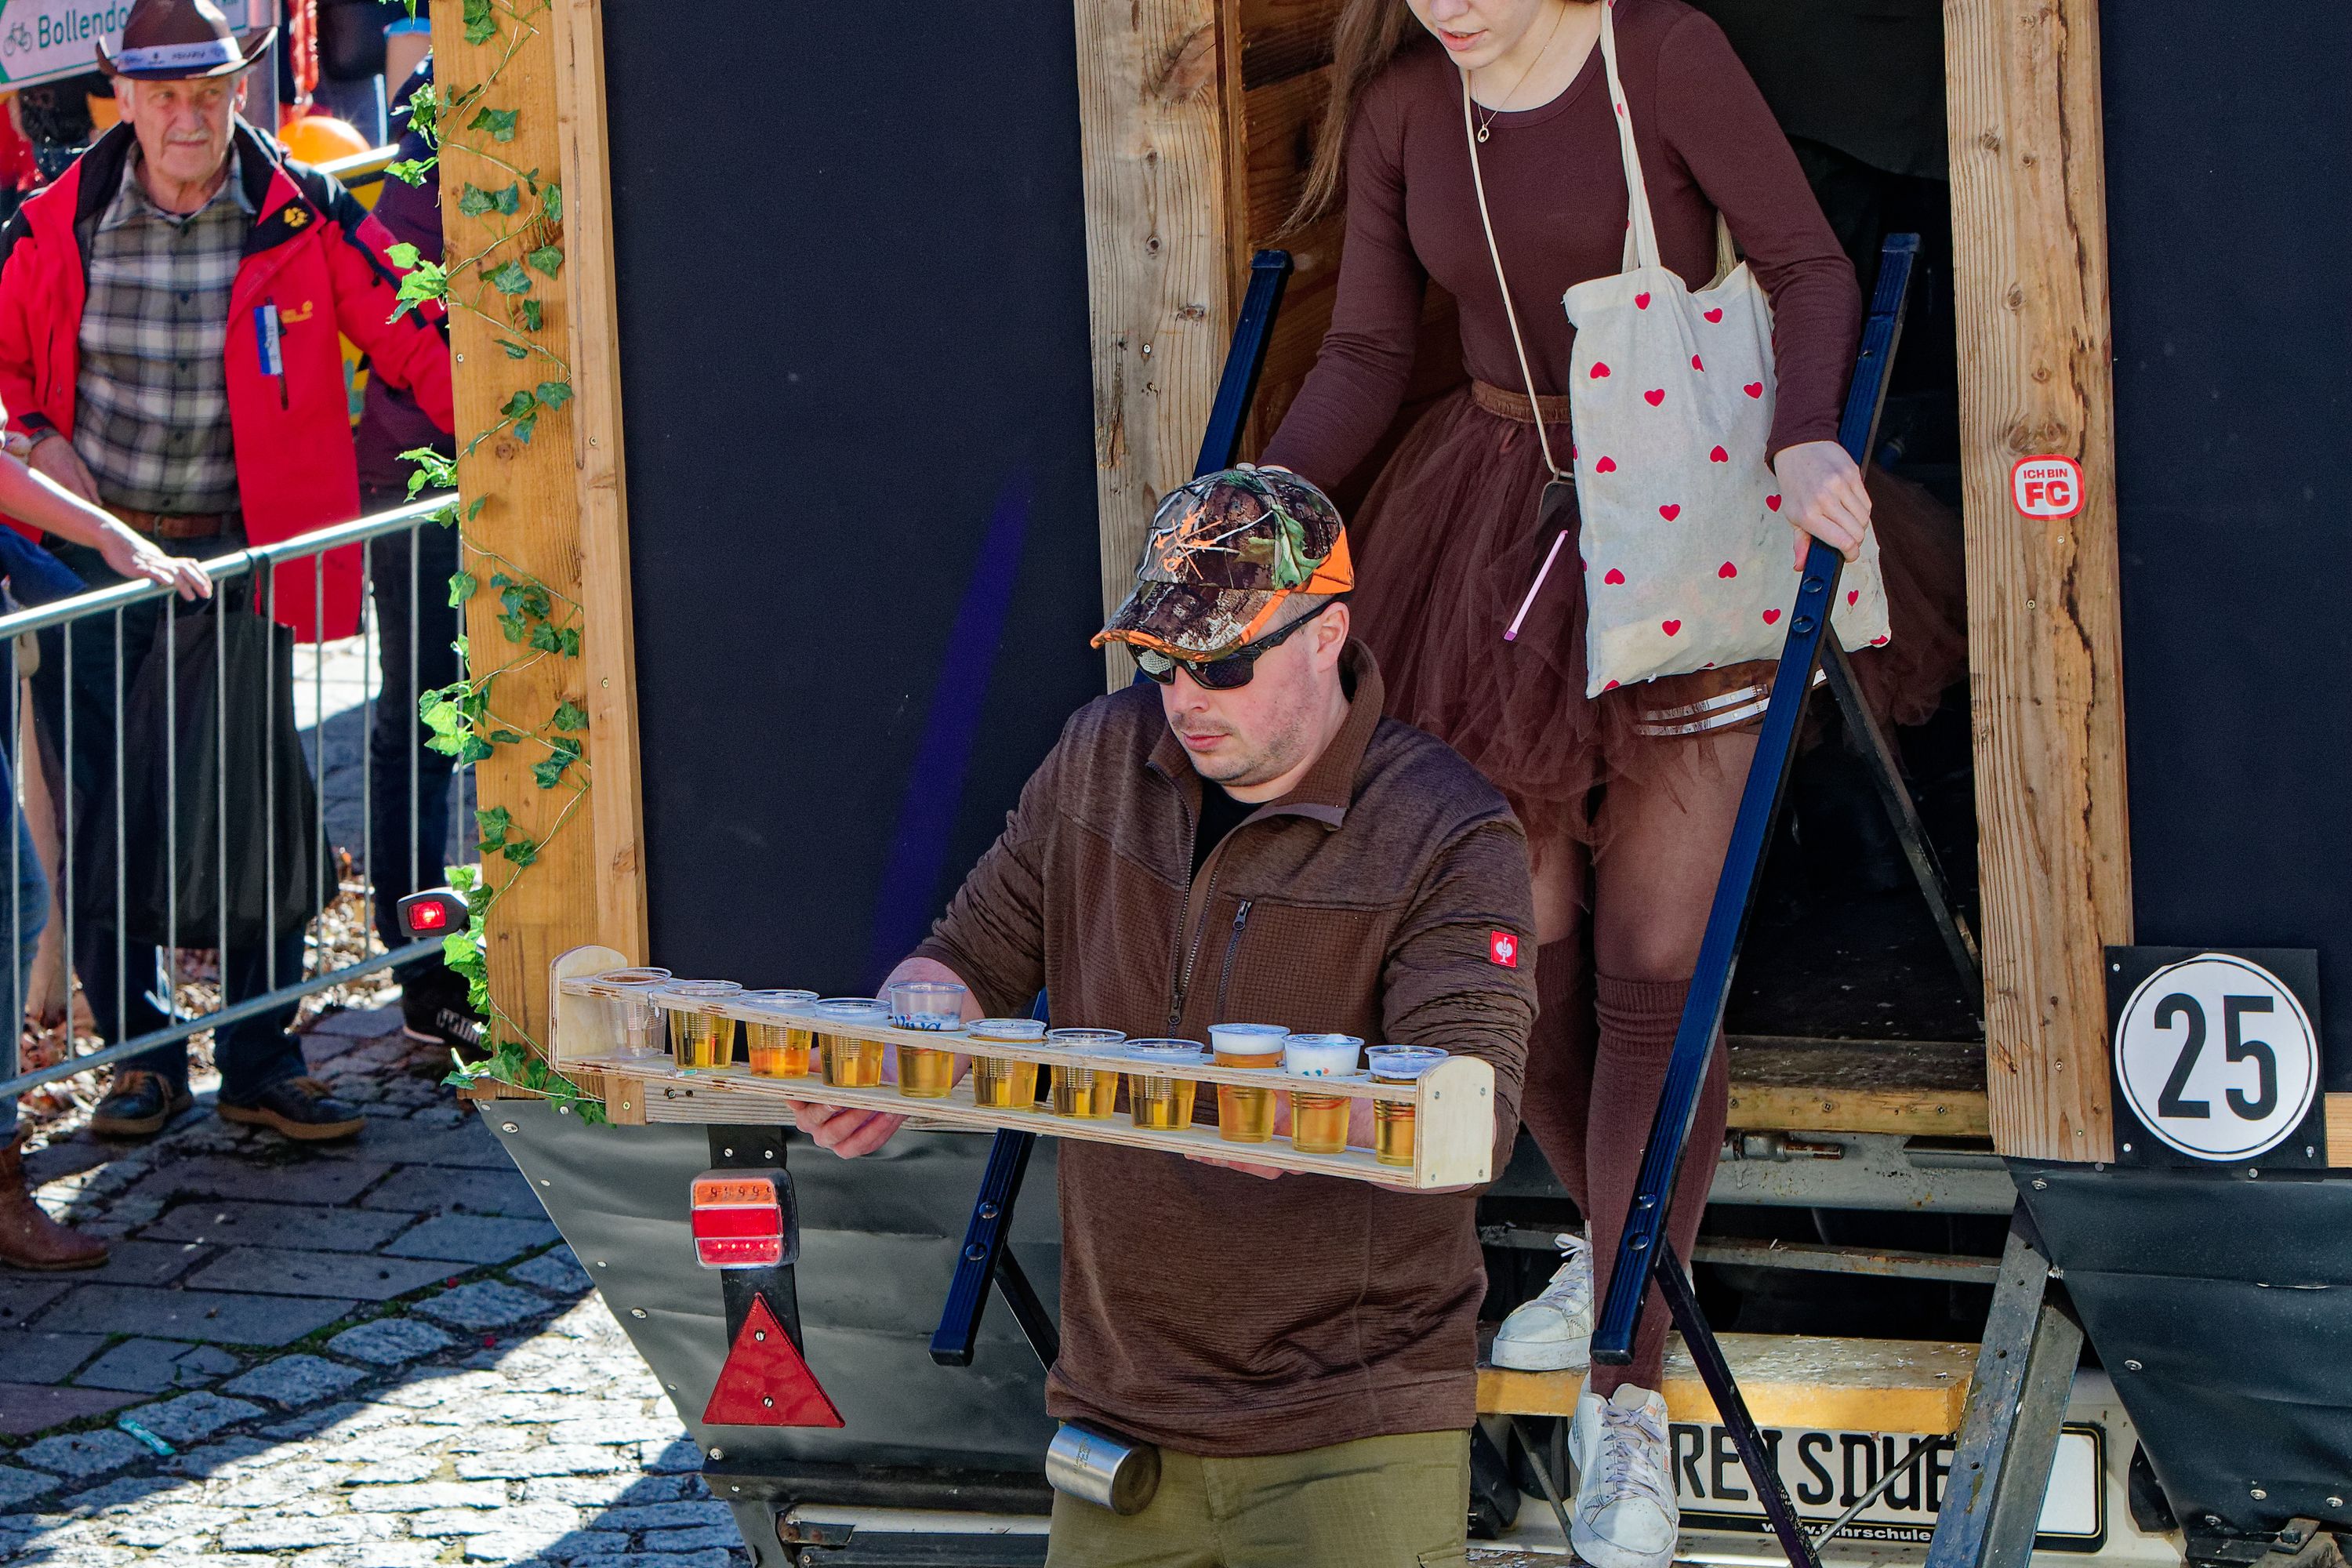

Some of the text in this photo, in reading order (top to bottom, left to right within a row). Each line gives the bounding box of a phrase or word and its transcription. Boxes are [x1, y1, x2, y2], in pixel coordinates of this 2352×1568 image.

[2023, 468, 2068, 479] ICH BIN
[2024, 481, 2070, 507] FC
[2154, 993, 2278, 1120] 25
[1762, 1523, 1931, 1541] ww.fhrschule
